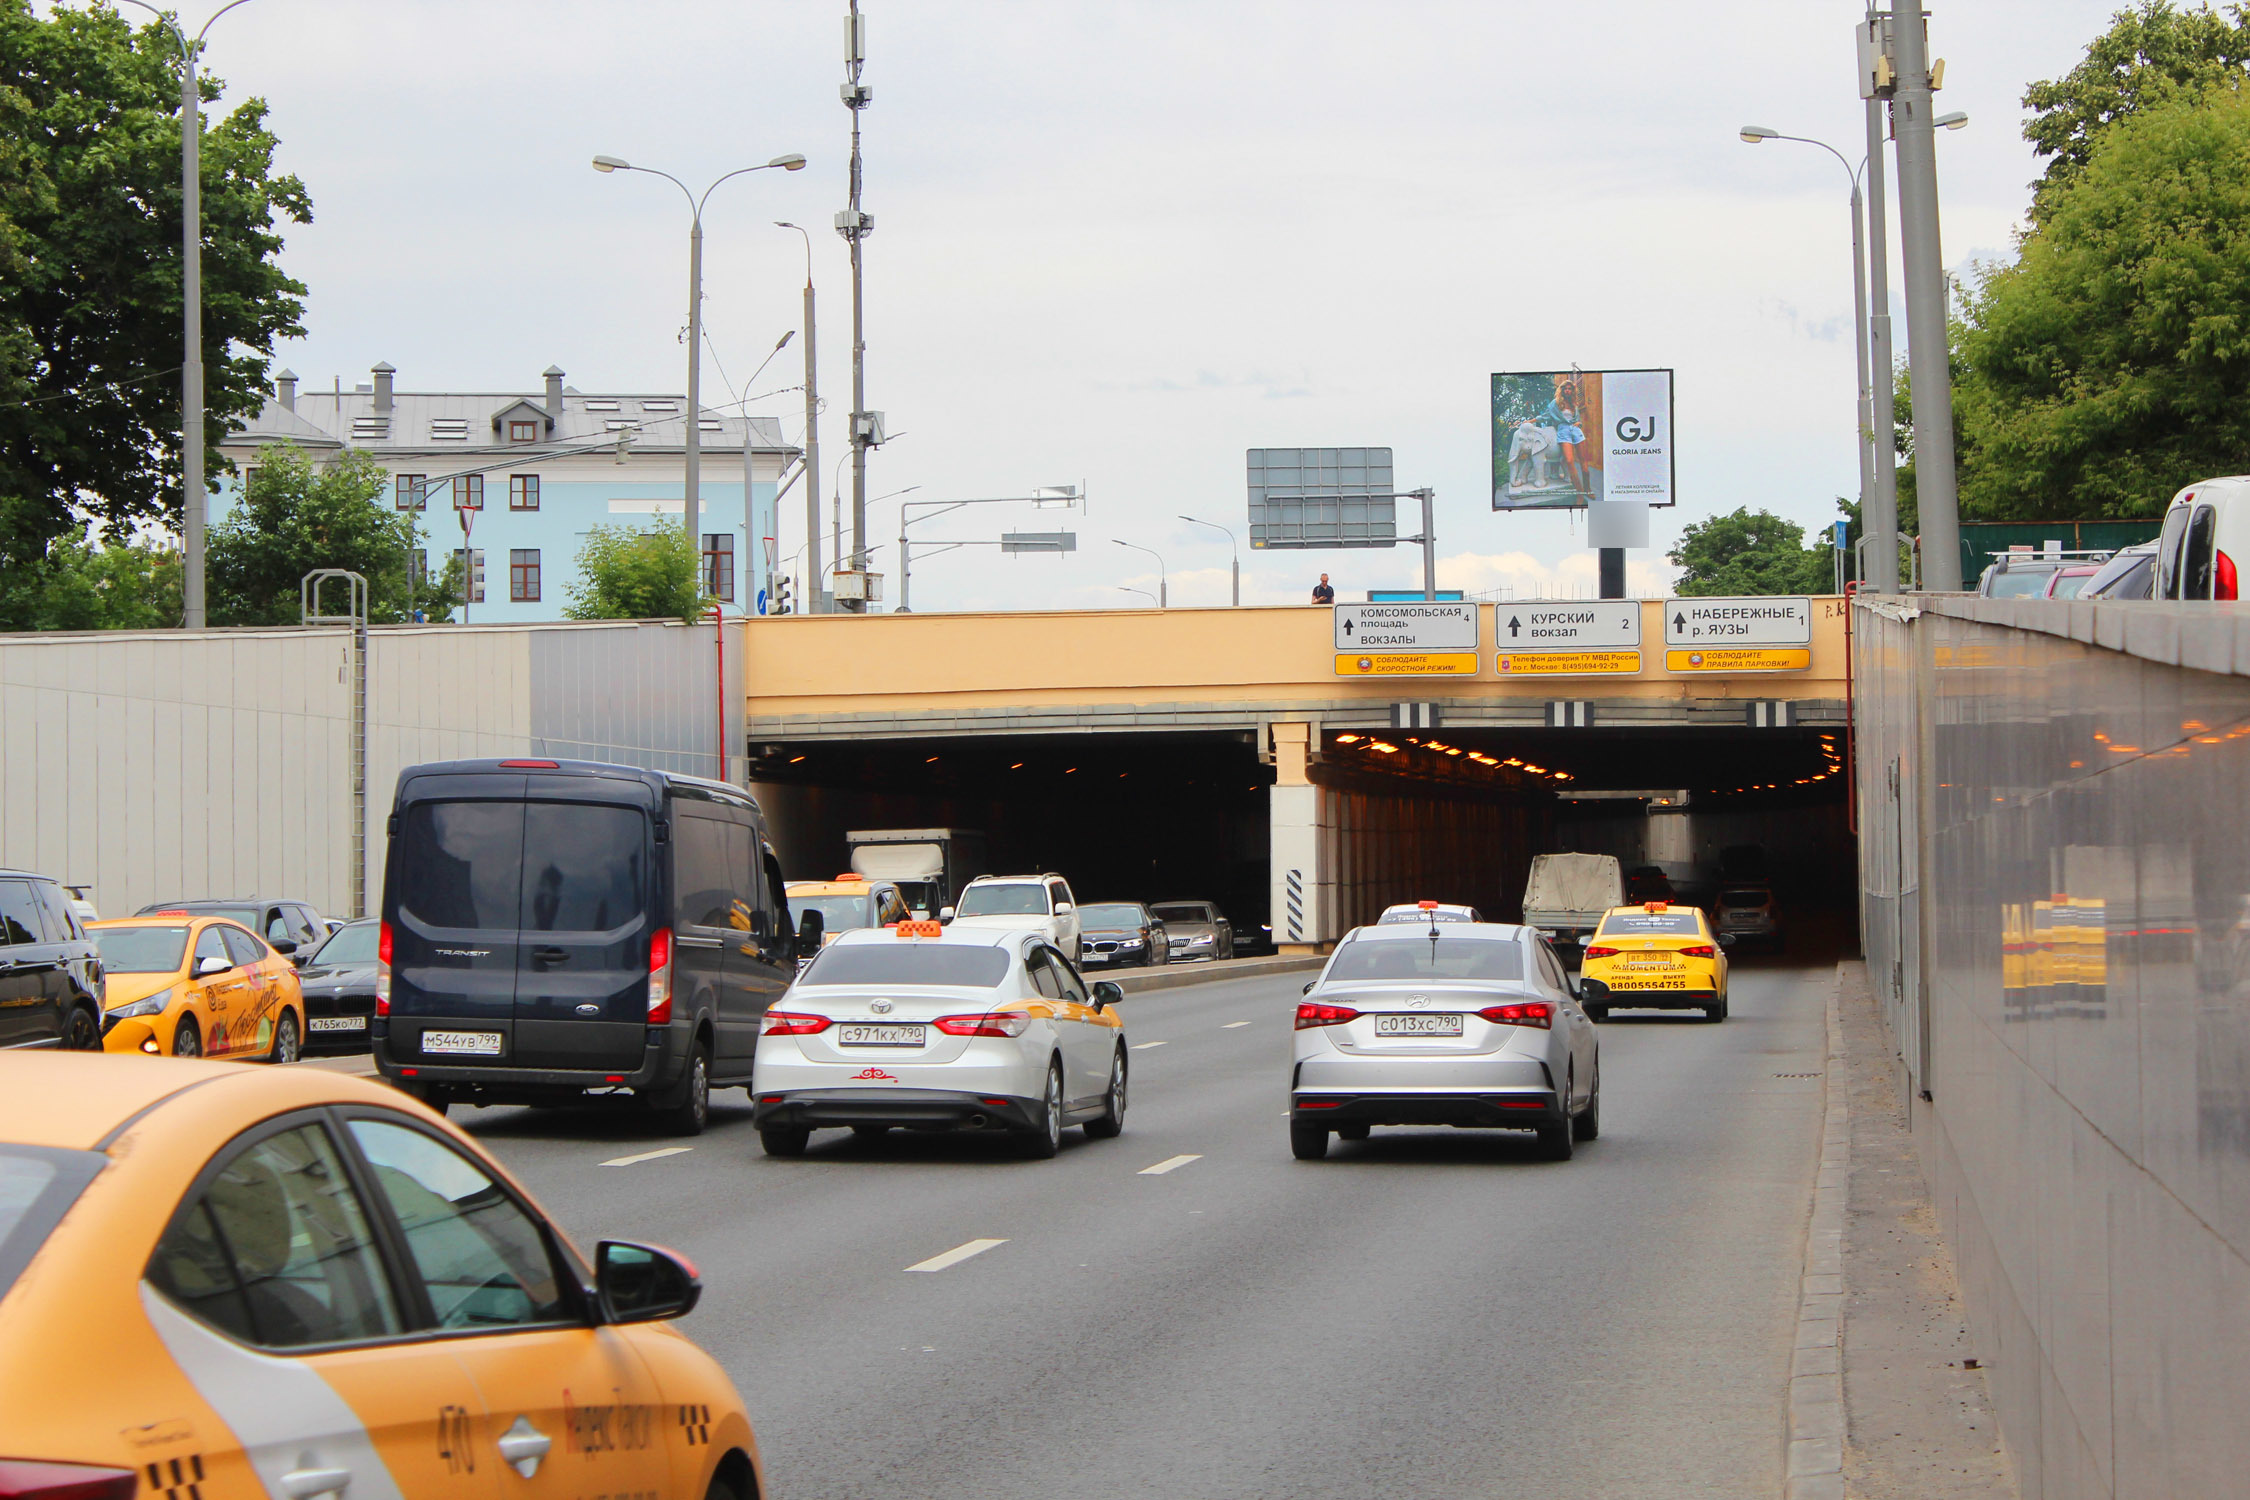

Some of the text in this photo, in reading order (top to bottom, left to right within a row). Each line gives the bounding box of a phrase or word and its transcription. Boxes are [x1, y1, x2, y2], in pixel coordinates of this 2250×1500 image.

[1616, 416, 1655, 442] GJ
[1360, 608, 1461, 618] КОМСОМОЛЬСКАЯ
[1463, 614, 1470, 622] 4
[1531, 611, 1595, 624] КУРСКИЙ
[1692, 607, 1795, 619] НАБЕРЕЖНЫЕ
[1360, 620, 1409, 629] площадь
[1622, 618, 1629, 629] 2
[1798, 615, 1804, 625] 1
[1531, 628, 1577, 637] вокзал
[1692, 624, 1749, 637] р. ЯУЗЫ
[1360, 635, 1416, 645] ВОКЗАЛЫ
[1706, 651, 1762, 659] СОБЛЮДАЙТЕ
[1562, 663, 1619, 671] 8(495)694-92-29
[1706, 660, 1743, 668] ПРАВИЛА
[1611, 981, 1686, 989] 88005554755
[1437, 1017, 1458, 1027] 790
[900, 1027, 920, 1038] 790
[478, 1034, 497, 1045] 799
